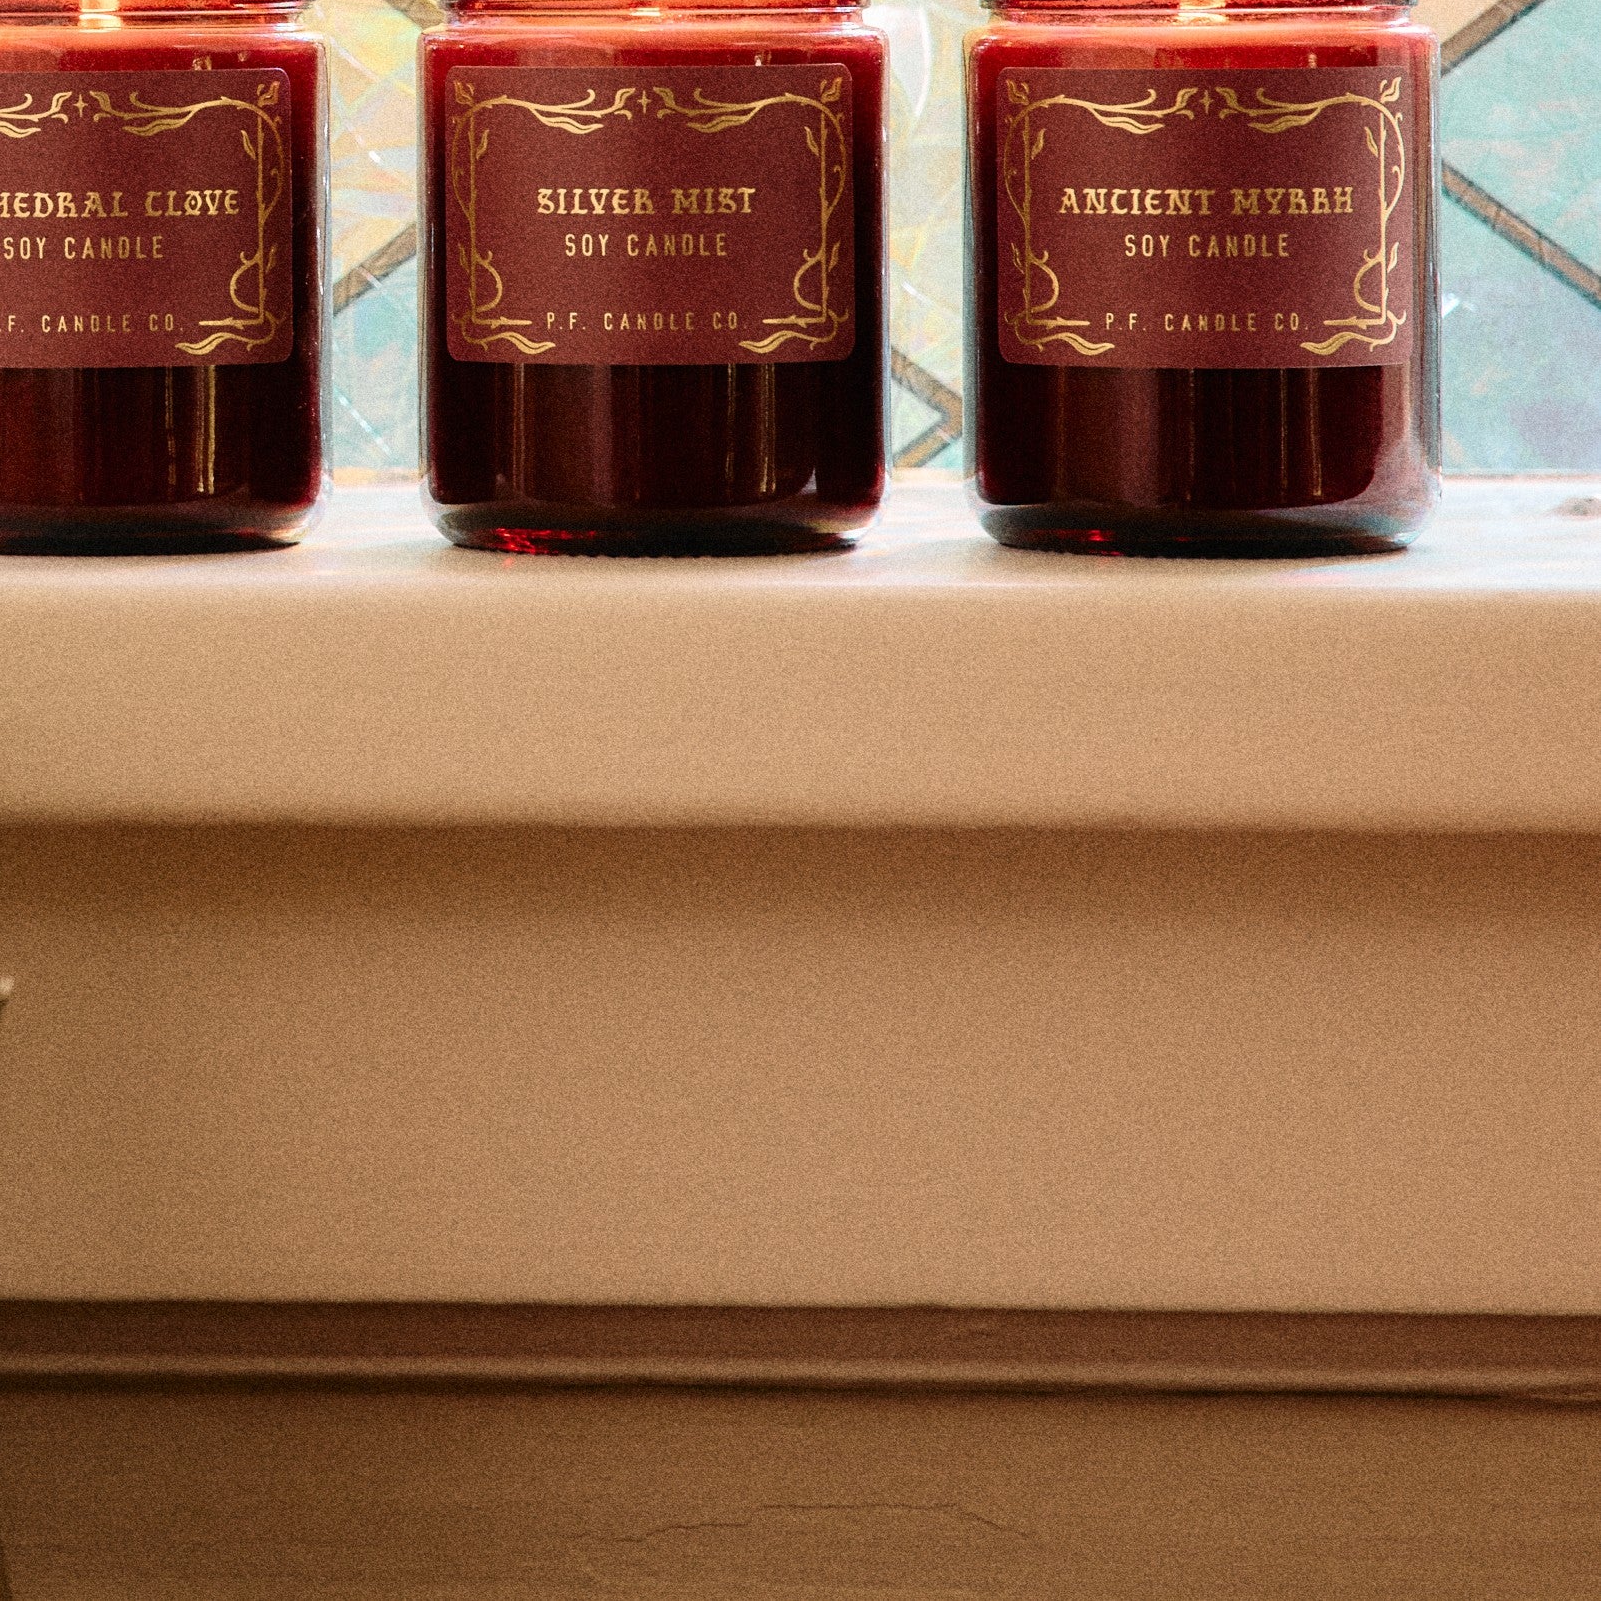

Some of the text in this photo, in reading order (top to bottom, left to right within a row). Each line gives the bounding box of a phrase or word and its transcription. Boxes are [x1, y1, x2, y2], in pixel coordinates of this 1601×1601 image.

[144, 189, 240, 217] CLOVE
[537, 187, 757, 216] SILVER MIST
[1058, 186, 1354, 216] ANCIENT MYRRH
[3, 235, 164, 261] SOY CANDLE
[565, 233, 728, 258] SOY CANDLE
[1124, 233, 1290, 258] SOY CANDLE
[42, 314, 132, 333] CANDLE
[149, 314, 185, 332] CO.
[546, 312, 586, 331] P.F.
[603, 312, 696, 331] CANDLE
[1105, 312, 1146, 331] P.F.
[1165, 312, 1258, 331] CANDLE
